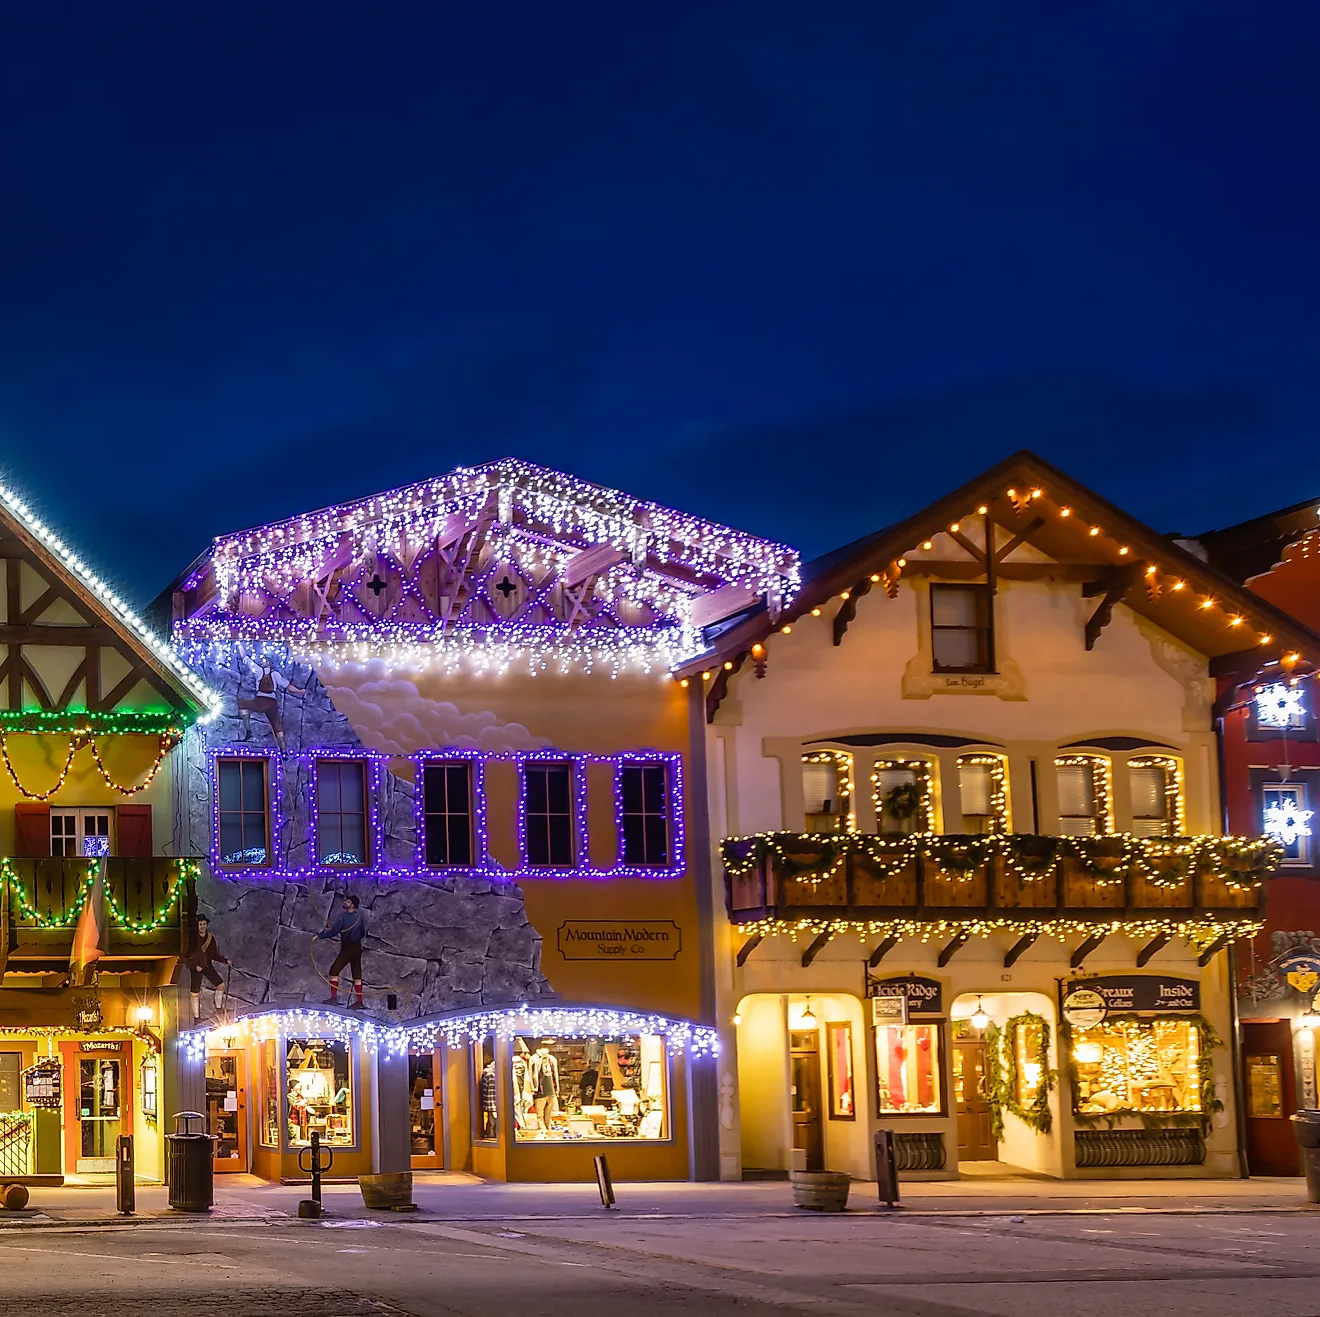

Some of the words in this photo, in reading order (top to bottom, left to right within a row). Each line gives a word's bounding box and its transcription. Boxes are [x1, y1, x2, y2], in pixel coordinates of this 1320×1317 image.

[565, 928, 622, 942] Mountain
[623, 927, 670, 942] Modern
[598, 944, 627, 956] Supply
[907, 983, 939, 1000] Ridge
[1160, 984, 1194, 998] Inside
